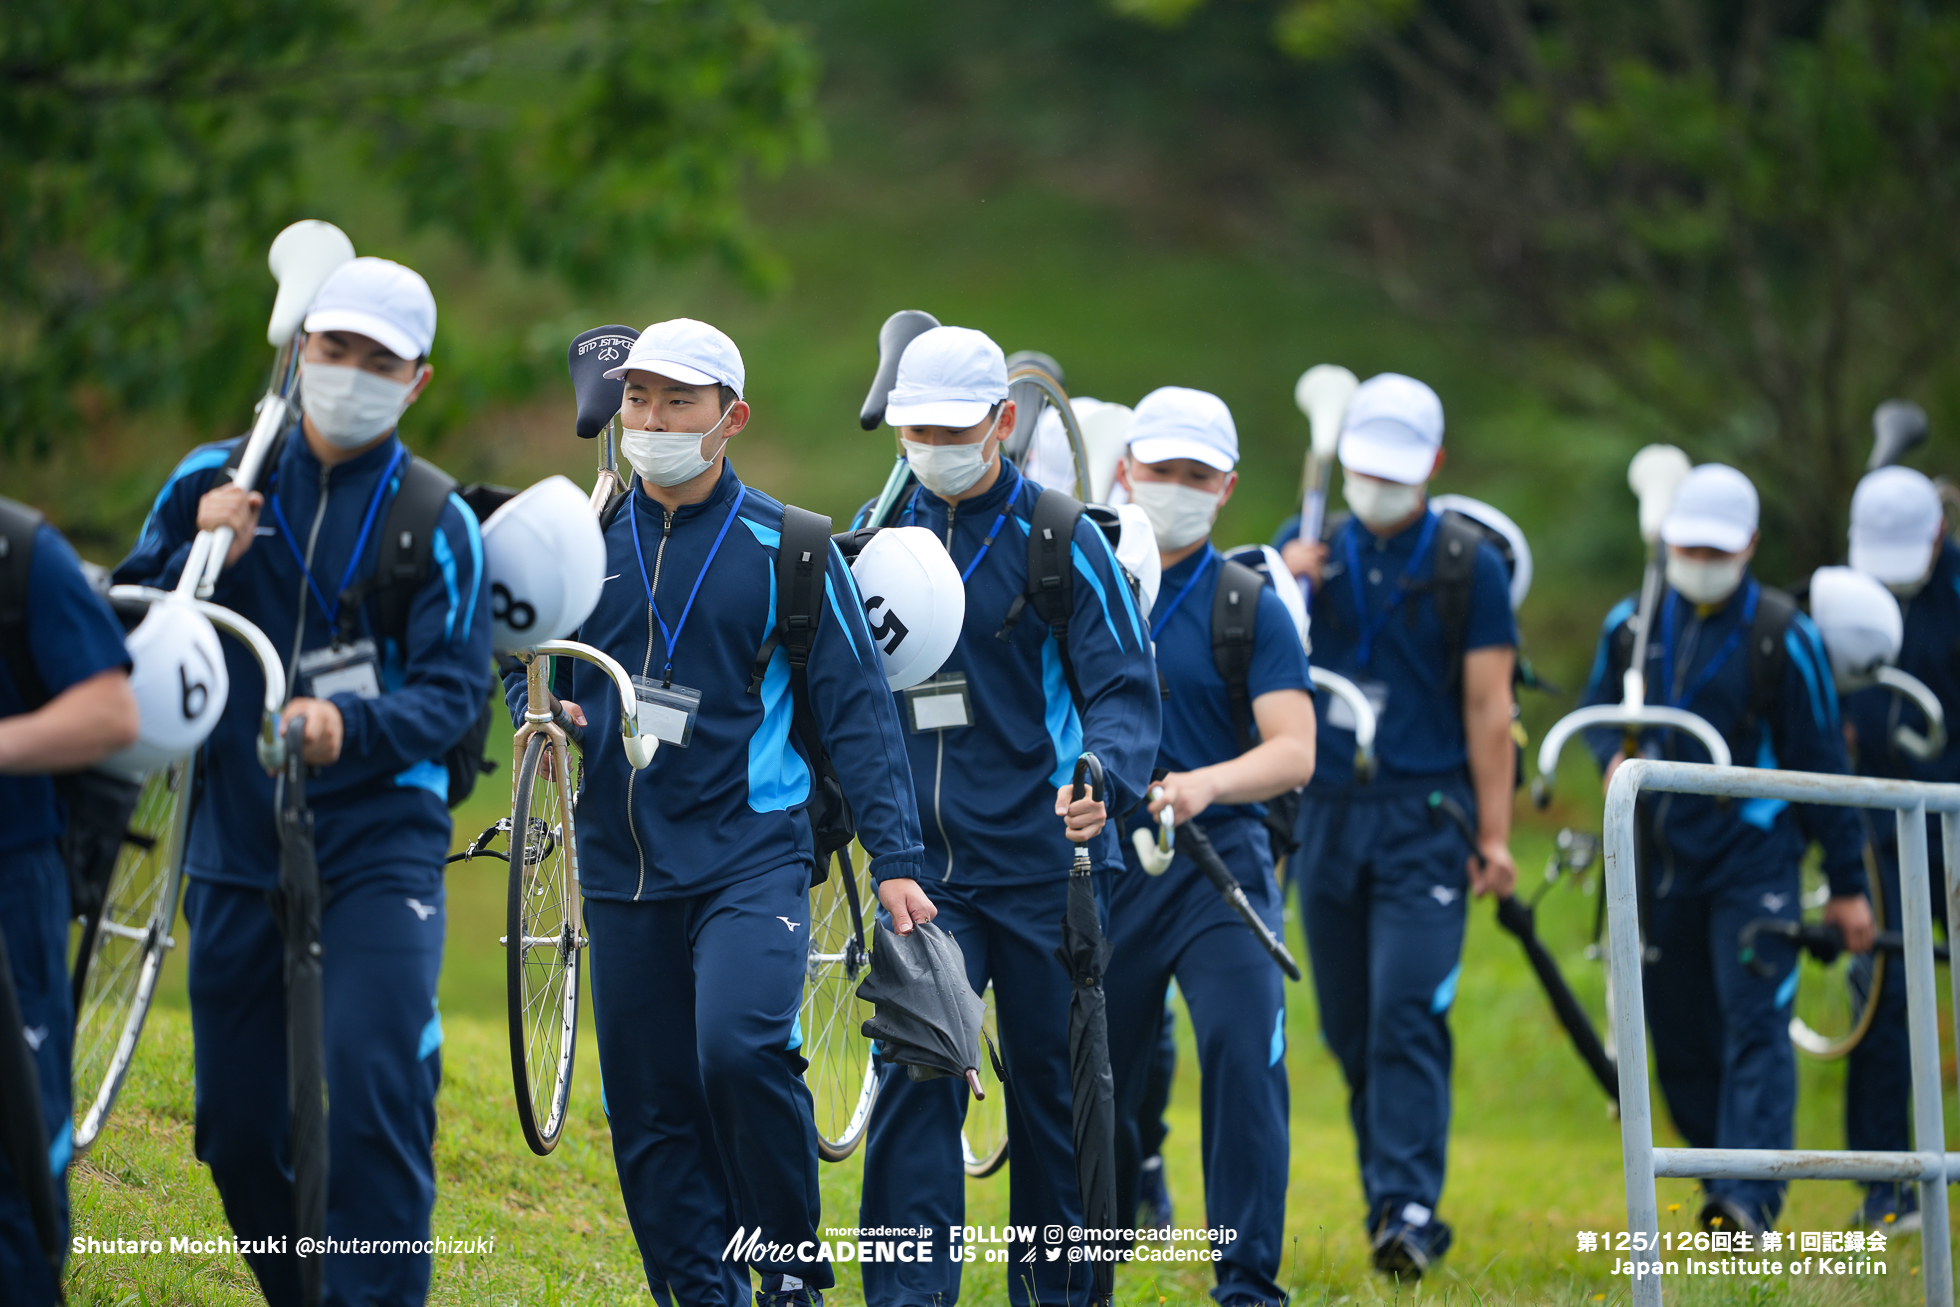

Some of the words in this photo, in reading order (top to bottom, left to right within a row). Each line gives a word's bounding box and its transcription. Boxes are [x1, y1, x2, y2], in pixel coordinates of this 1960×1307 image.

[578, 341, 597, 356] CLUB
[599, 338, 634, 351] EDALIST
[491, 582, 537, 632] 8
[865, 595, 910, 657] 5
